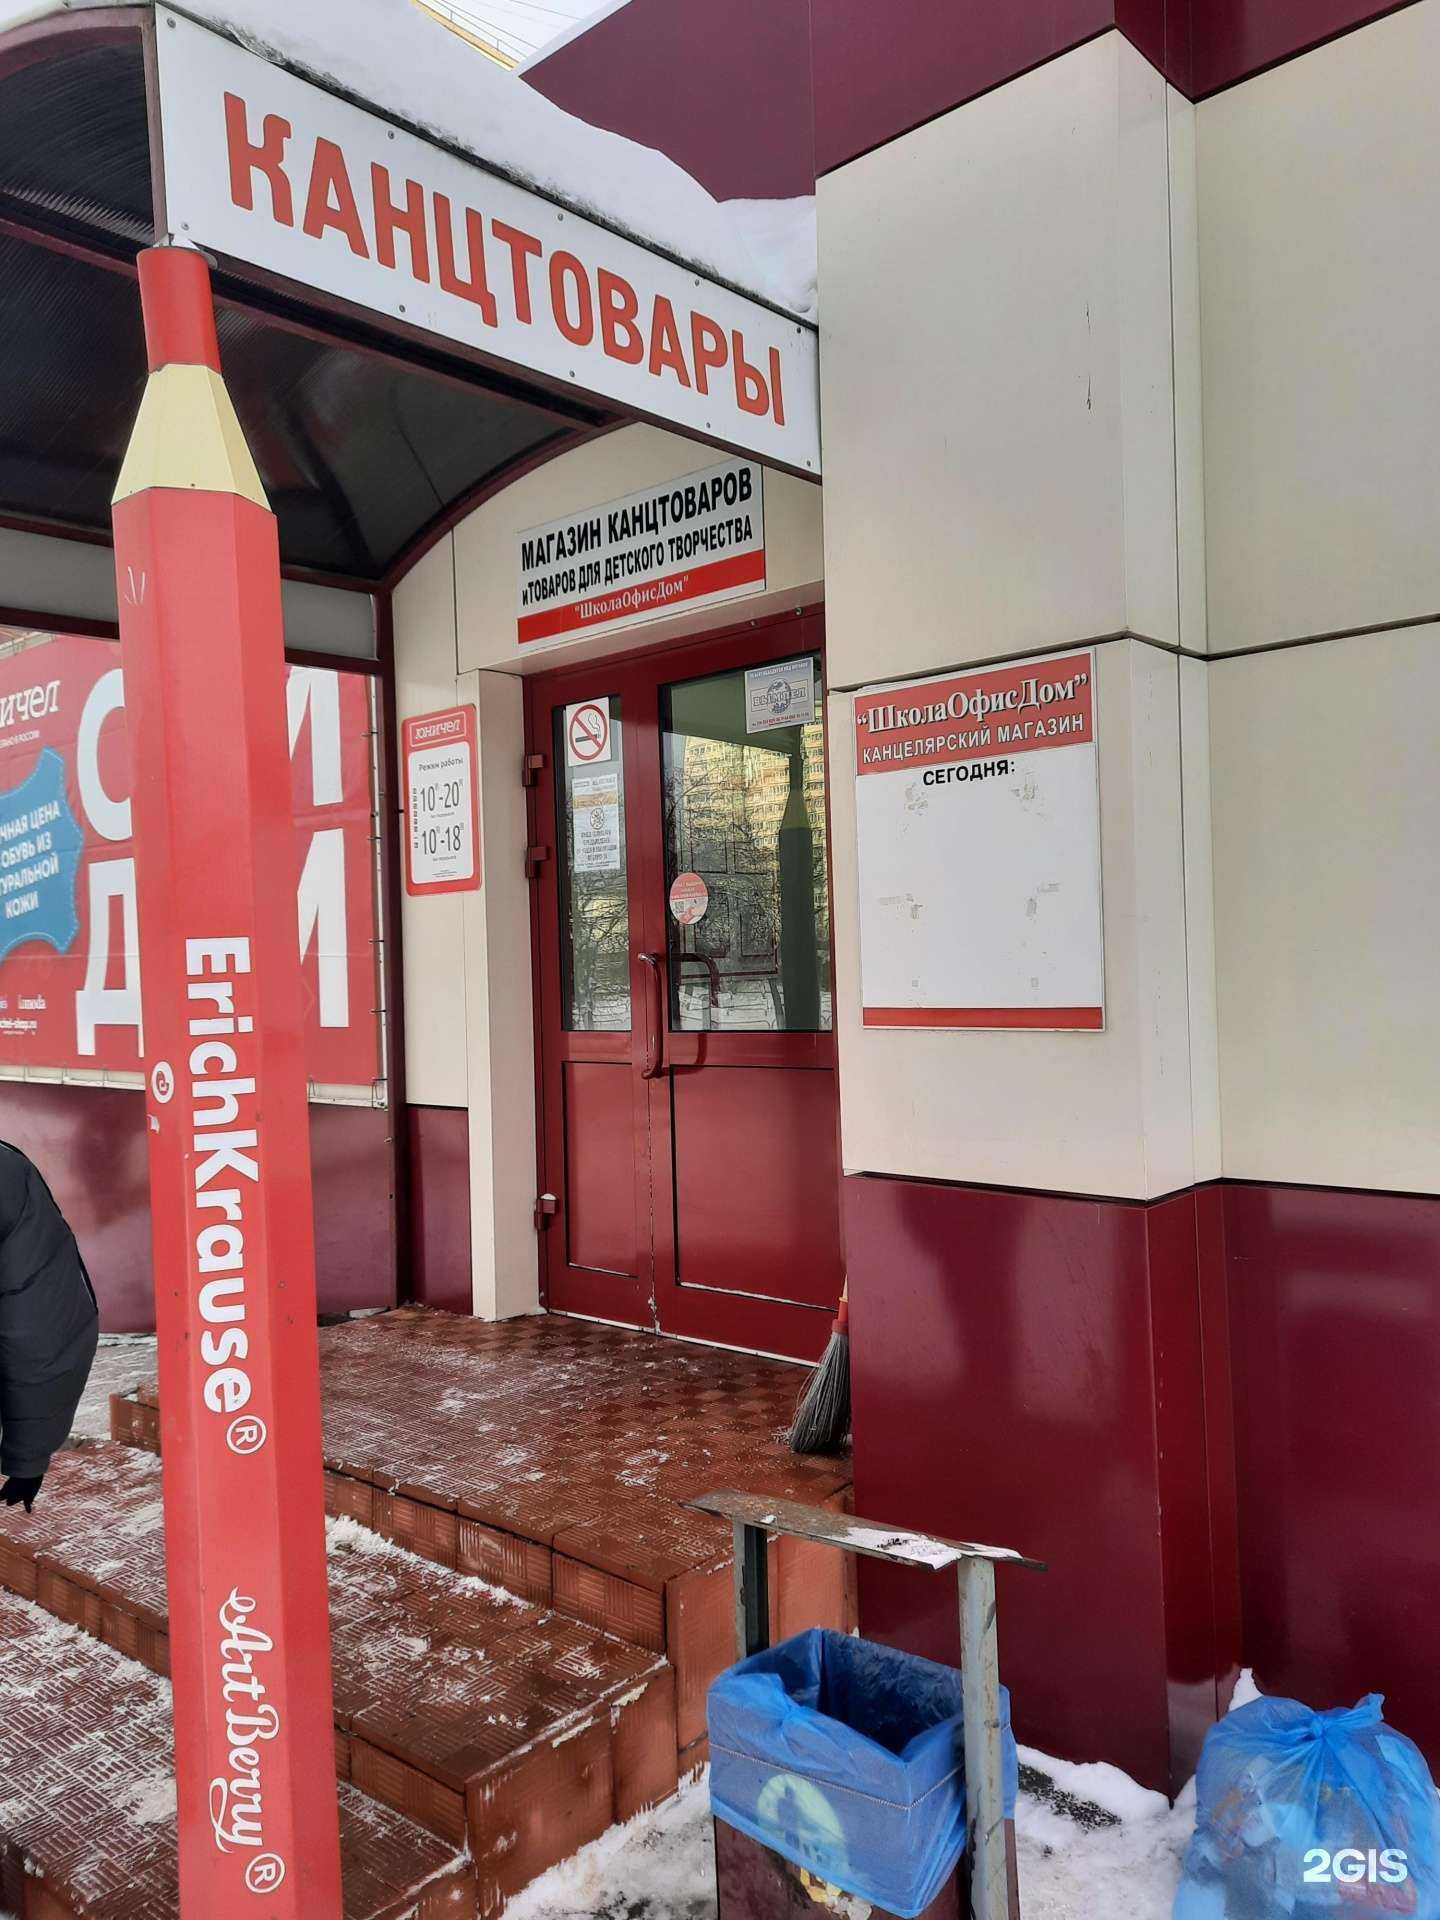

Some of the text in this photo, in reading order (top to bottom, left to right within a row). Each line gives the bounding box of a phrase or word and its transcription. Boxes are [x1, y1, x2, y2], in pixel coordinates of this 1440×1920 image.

[223, 91, 785, 426] КАНЦТОВАРЫ
[521, 467, 752, 571] МАГАЗИН КАНЦТОВАРОВ
[578, 560, 600, 593] ДЛЯ
[604, 543, 664, 586] ДЕТСКОГО
[668, 514, 752, 562] ТВОРЧЕСТВА
[862, 713, 1084, 764] КАНЦЕЛЯРСКИЙ МАГАЗИН
[923, 760, 1016, 786] СЕГОДНЯ:
[30, 800, 60, 829] ЦЕНА
[1, 831, 52, 868] ОБУВЬ ИЗ
[5, 891, 39, 919] КОЖИ
